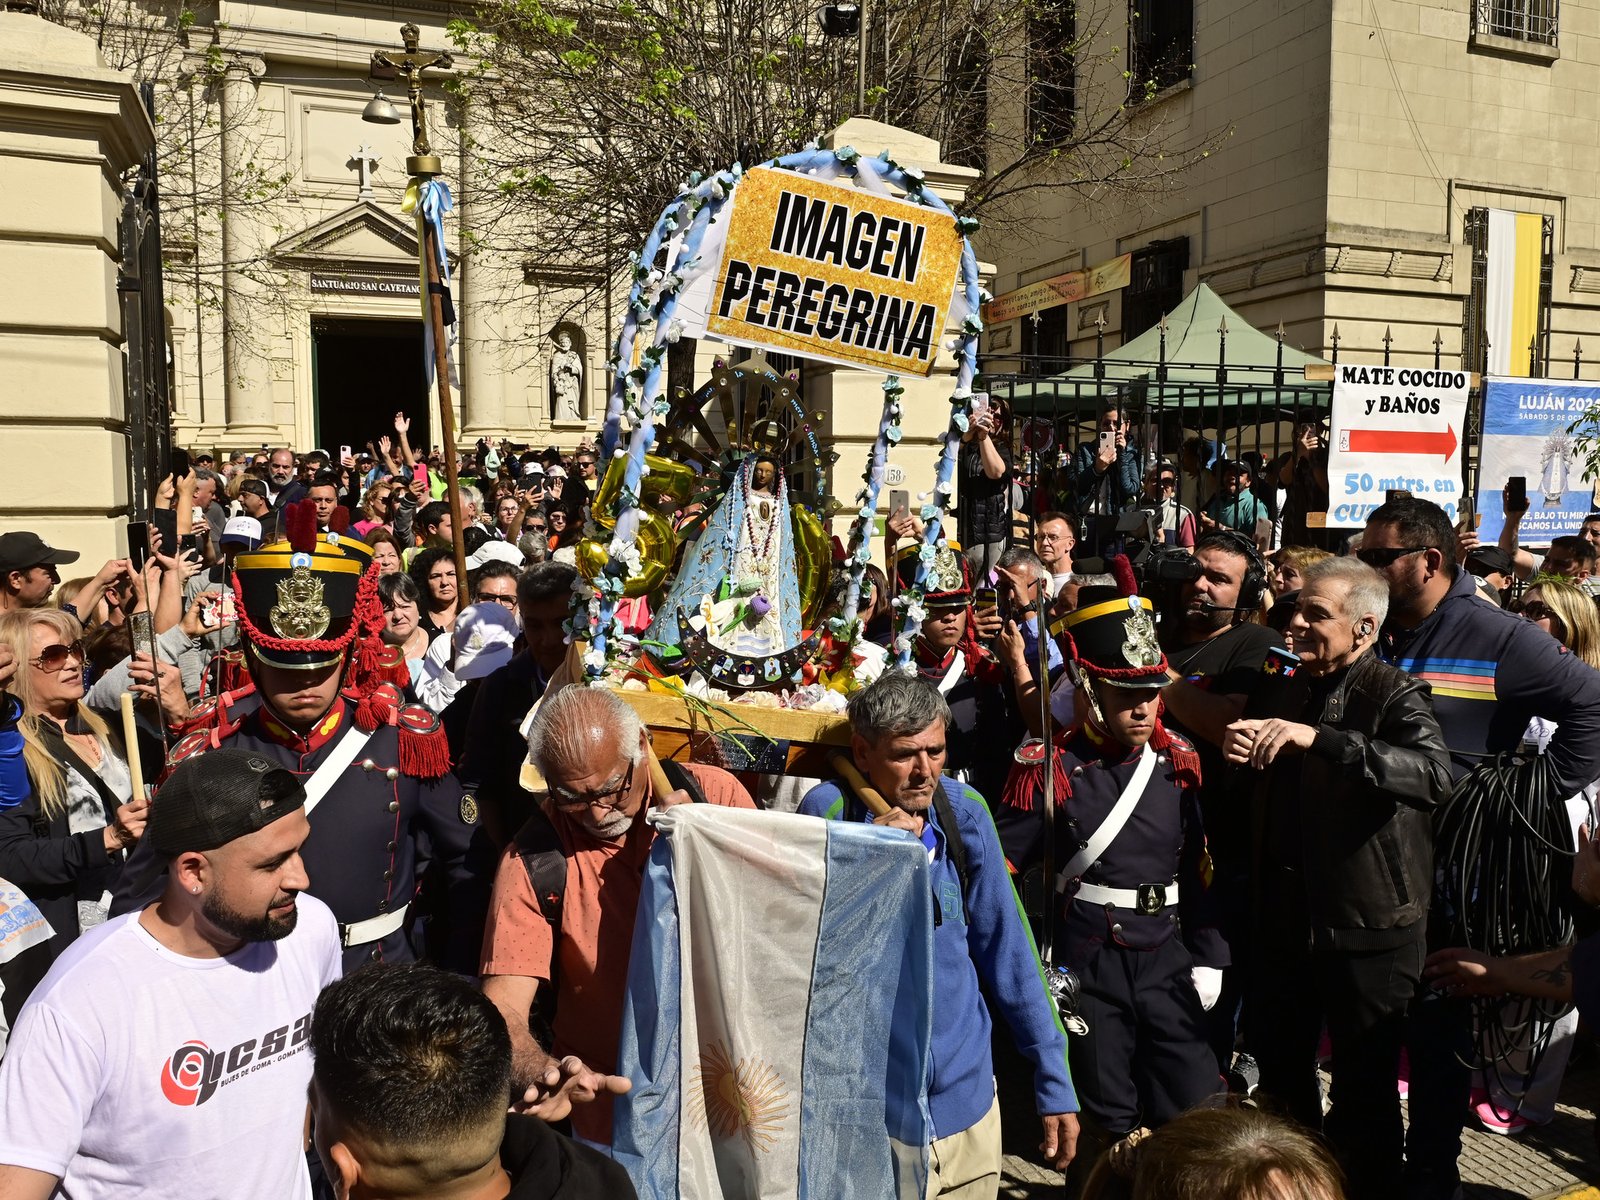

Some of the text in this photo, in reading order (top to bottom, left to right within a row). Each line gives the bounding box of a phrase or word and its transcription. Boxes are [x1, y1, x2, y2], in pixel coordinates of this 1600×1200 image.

[770, 190, 926, 285] IMAGEN
[312, 279, 360, 290] SANTUARIO
[361, 281, 377, 291] SAN
[718, 259, 937, 361] PEREGRINA
[1342, 366, 1465, 389] MATE COCIDO
[1365, 392, 1441, 415] y BAÑOS
[1519, 392, 1565, 411] LUJÁN
[1344, 473, 1455, 495] 50 mtrs. en
[1534, 512, 1555, 520] BAJO
[1557, 512, 1567, 520] TU
[1552, 522, 1563, 530] LA
[221, 1073, 239, 1087] BUJES
[241, 1068, 250, 1077] DE
[251, 1060, 271, 1072] GOMA
[277, 1049, 296, 1062] GOMA
